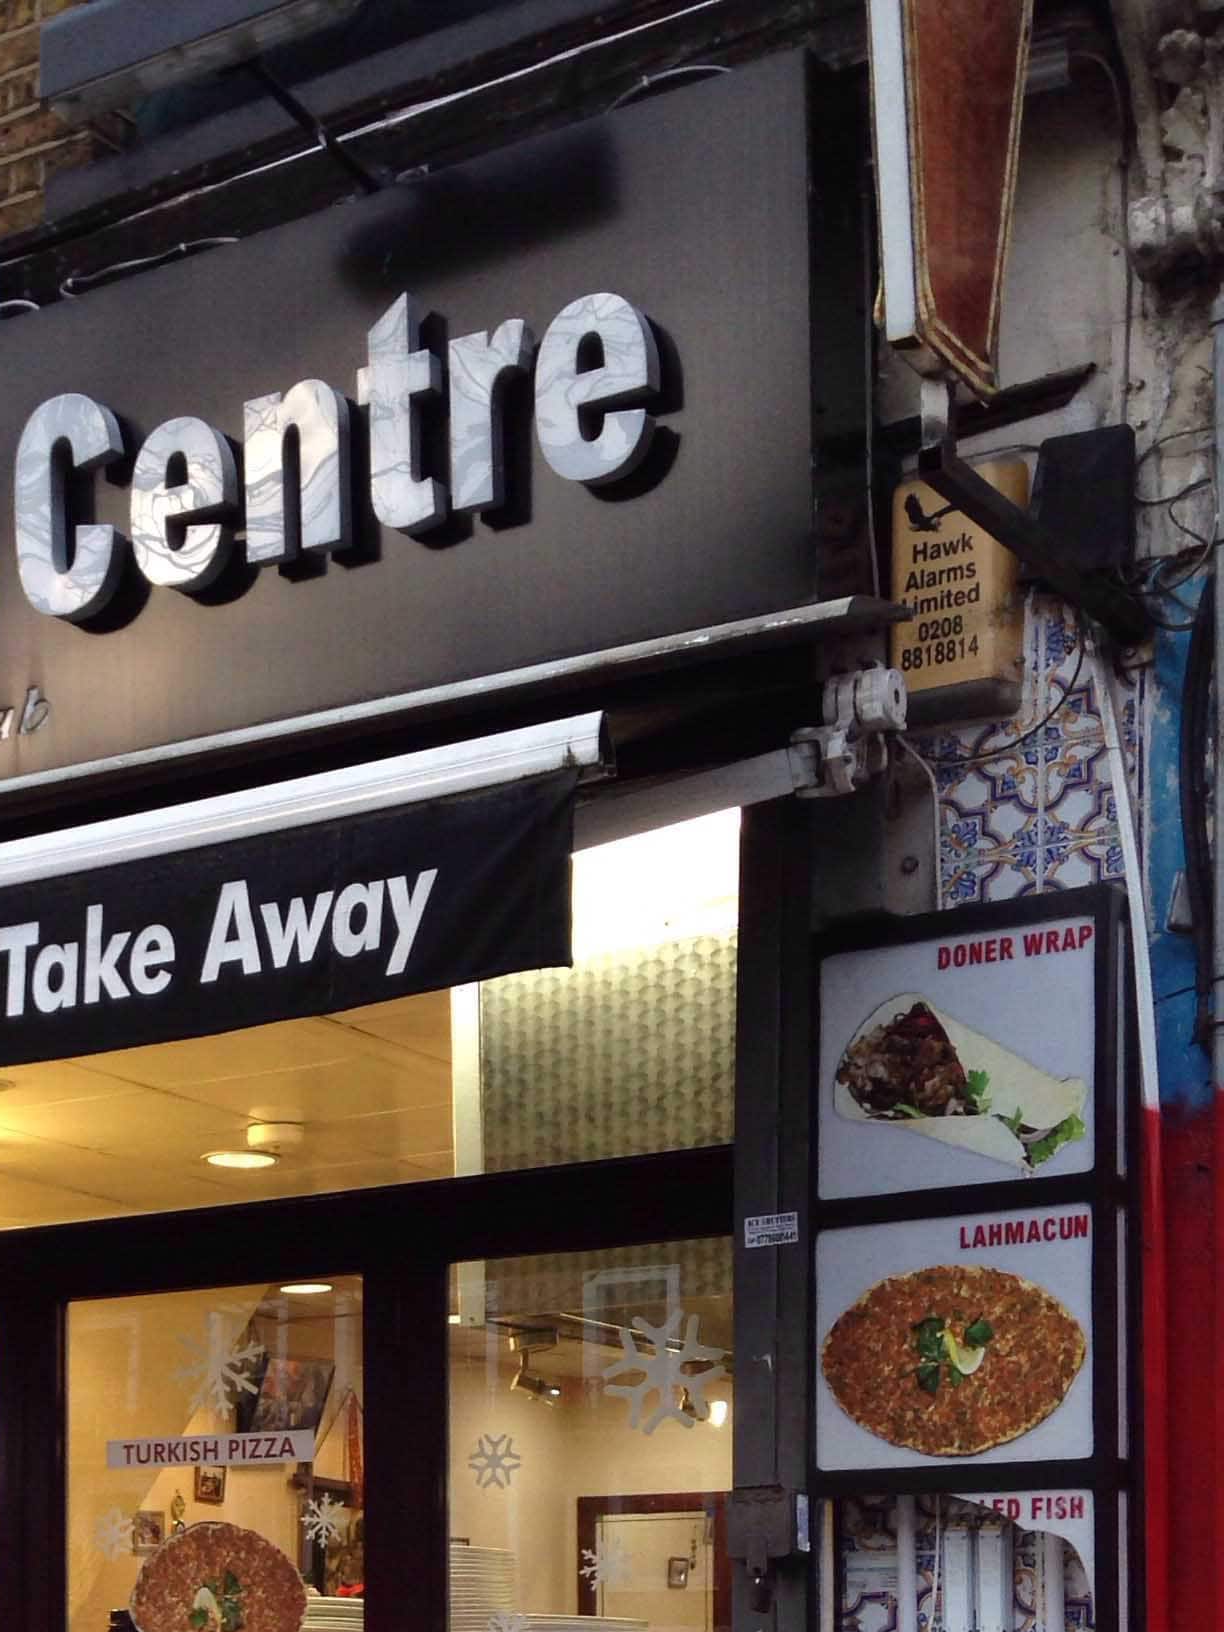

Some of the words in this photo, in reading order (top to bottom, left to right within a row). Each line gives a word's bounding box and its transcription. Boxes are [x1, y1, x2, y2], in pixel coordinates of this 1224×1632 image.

[14, 291, 659, 620] Centre
[912, 532, 974, 564] Hawk
[904, 561, 977, 592] Alarms
[918, 615, 964, 643] 0208
[901, 635, 980, 672] 8818814
[199, 867, 440, 985] Away
[937, 936, 1015, 971] DONER
[1023, 924, 1094, 957] WRAP
[958, 1214, 1089, 1250] LAHMACUN
[123, 1440, 219, 1465] TURKISH
[228, 1436, 296, 1460] PIZZA
[1031, 1495, 1085, 1521] FISH
